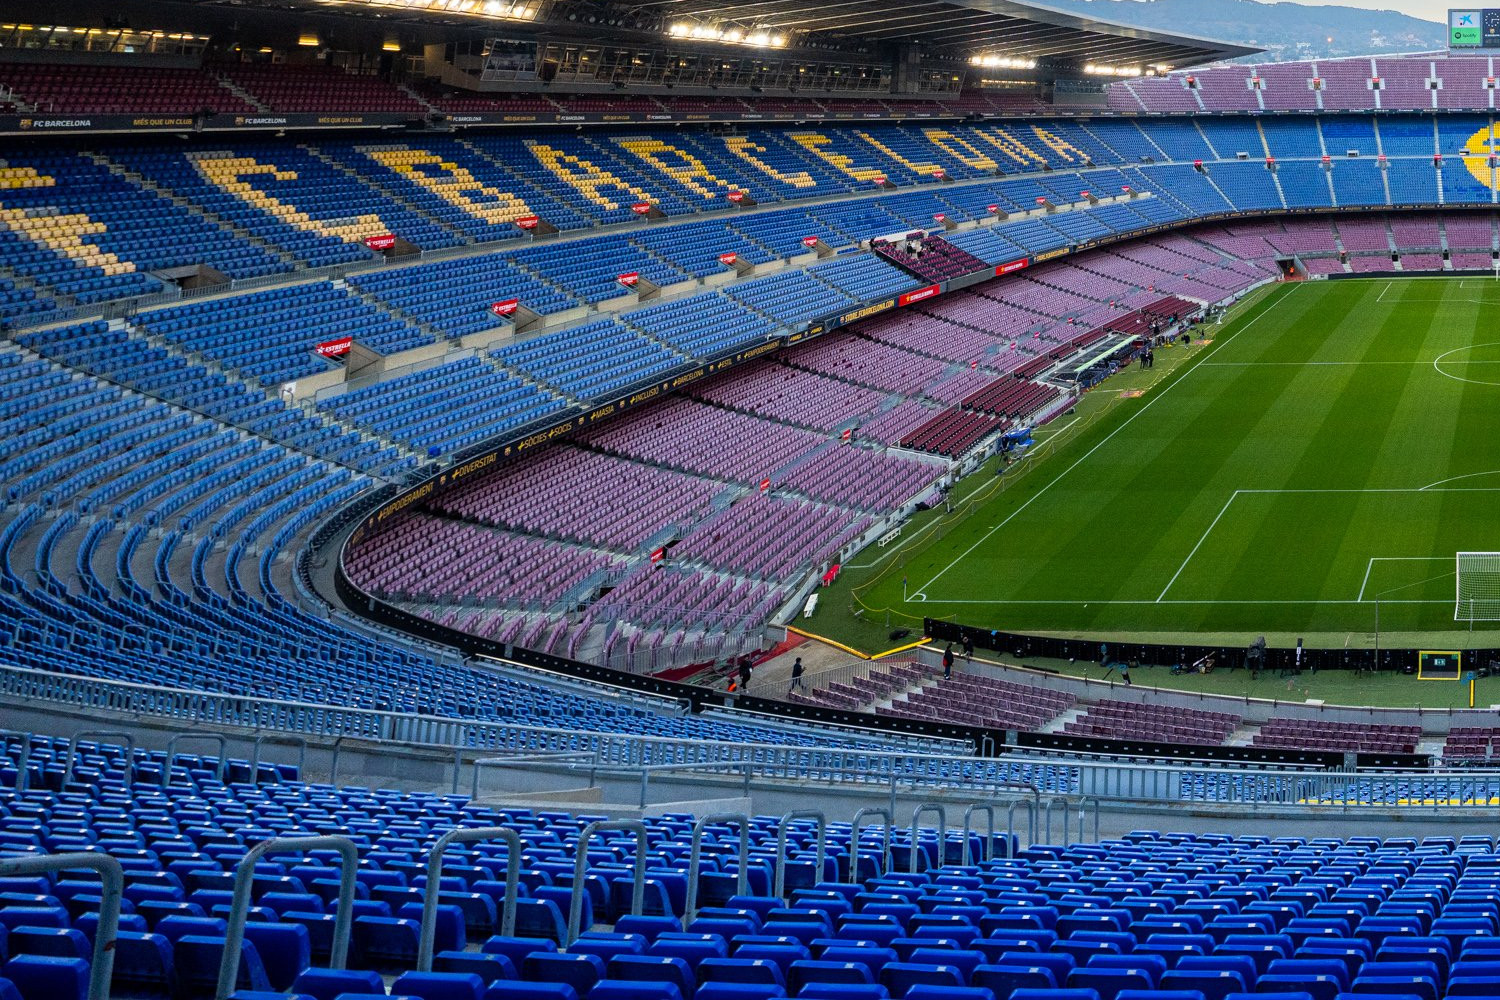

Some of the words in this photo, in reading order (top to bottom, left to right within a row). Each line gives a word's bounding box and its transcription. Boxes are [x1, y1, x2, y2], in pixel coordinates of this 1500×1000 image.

[33, 120, 43, 128] FC
[44, 119, 91, 127] BARCELONA
[133, 118, 149, 126] MÉS
[352, 124, 1092, 235] BARCELONA
[845, 301, 895, 322] STORE.FCBARCELONA.COM
[325, 341, 351, 351] ESTRELLA
[452, 452, 497, 480] +DIVERSITAT
[377, 480, 434, 522] +EMPODERAMENT
